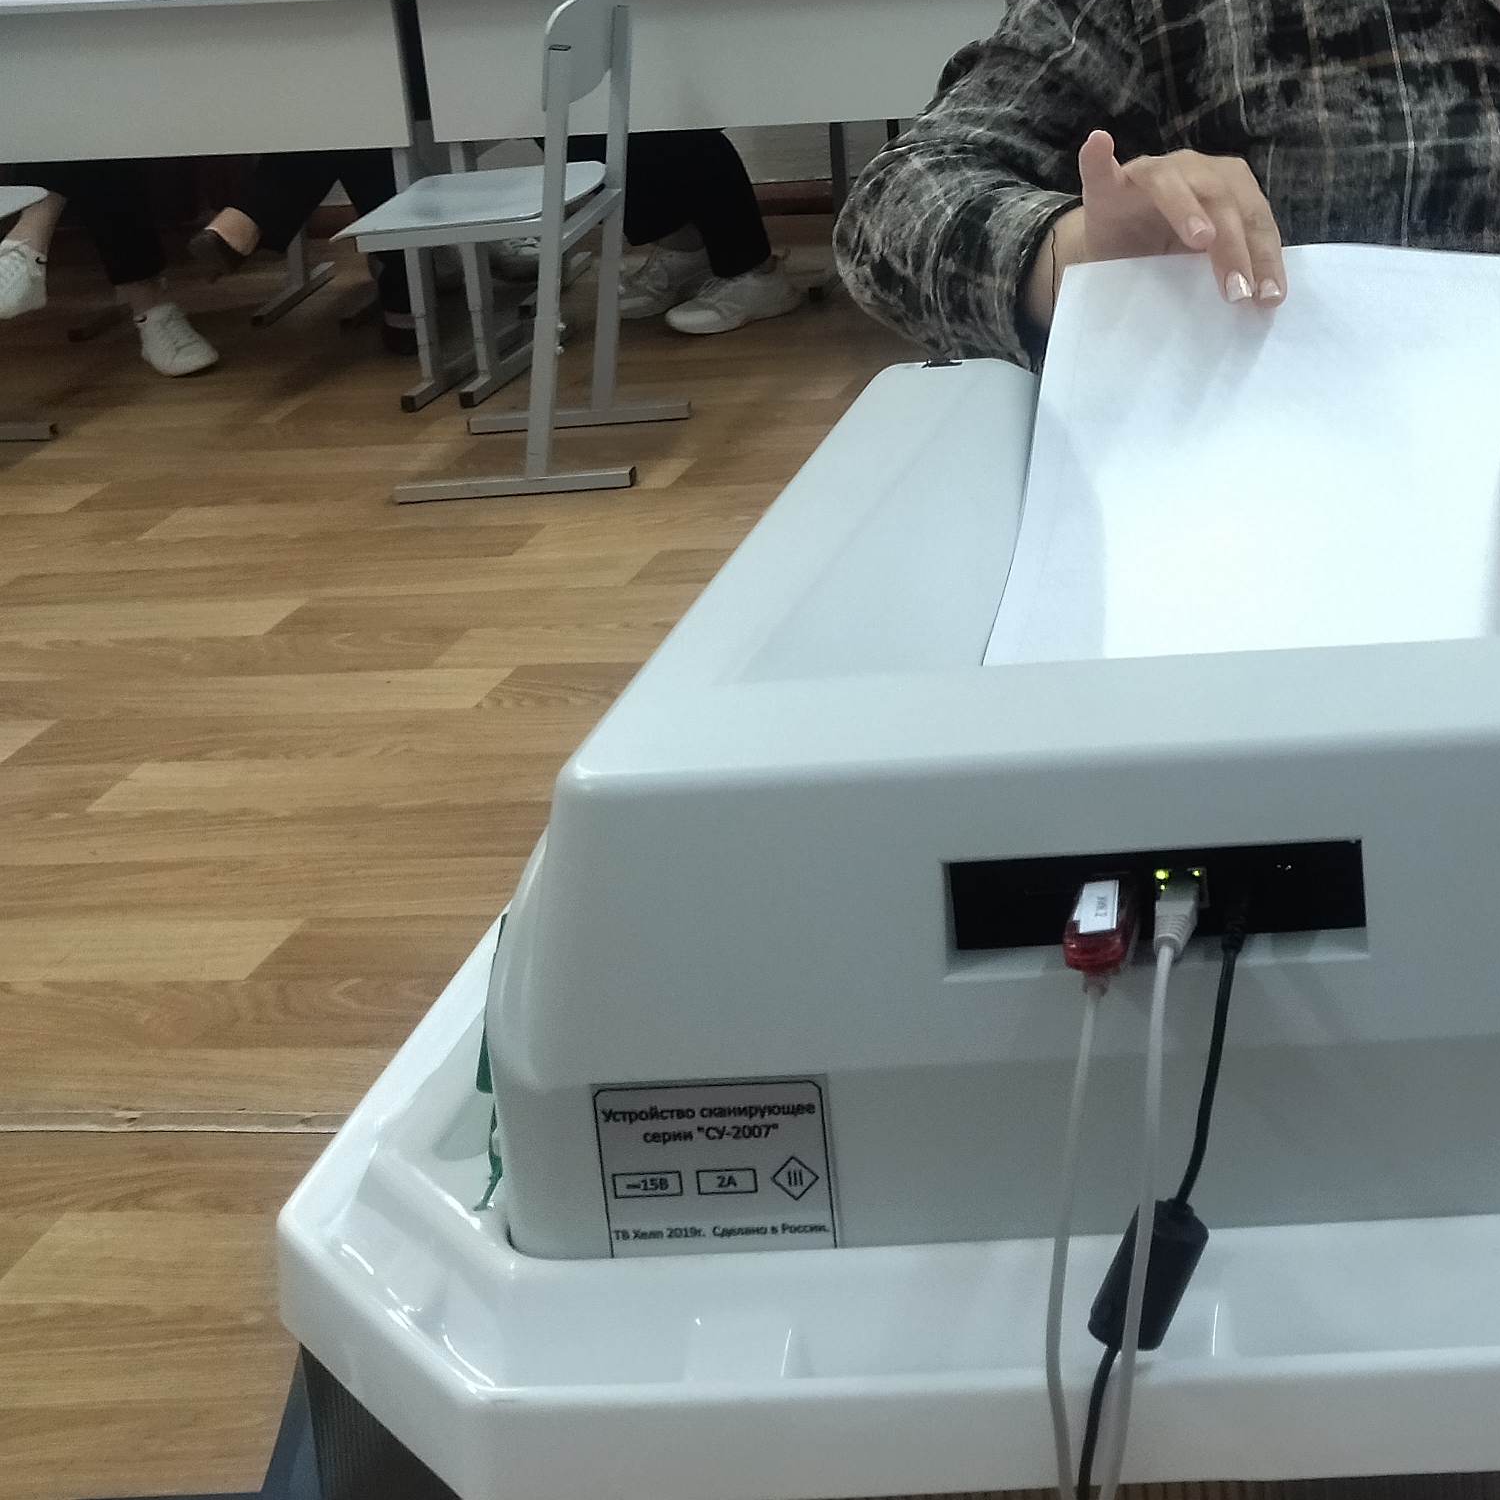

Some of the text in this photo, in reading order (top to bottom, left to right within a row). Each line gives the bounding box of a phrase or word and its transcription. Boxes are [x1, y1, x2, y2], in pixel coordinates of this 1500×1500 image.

[602, 1102, 816, 1125] Устройство сканирующее
[643, 1122, 779, 1146] серии "СУ-2007"
[712, 1224, 768, 1238] Сделано
[769, 1225, 778, 1234] в
[781, 1223, 830, 1235] России.
